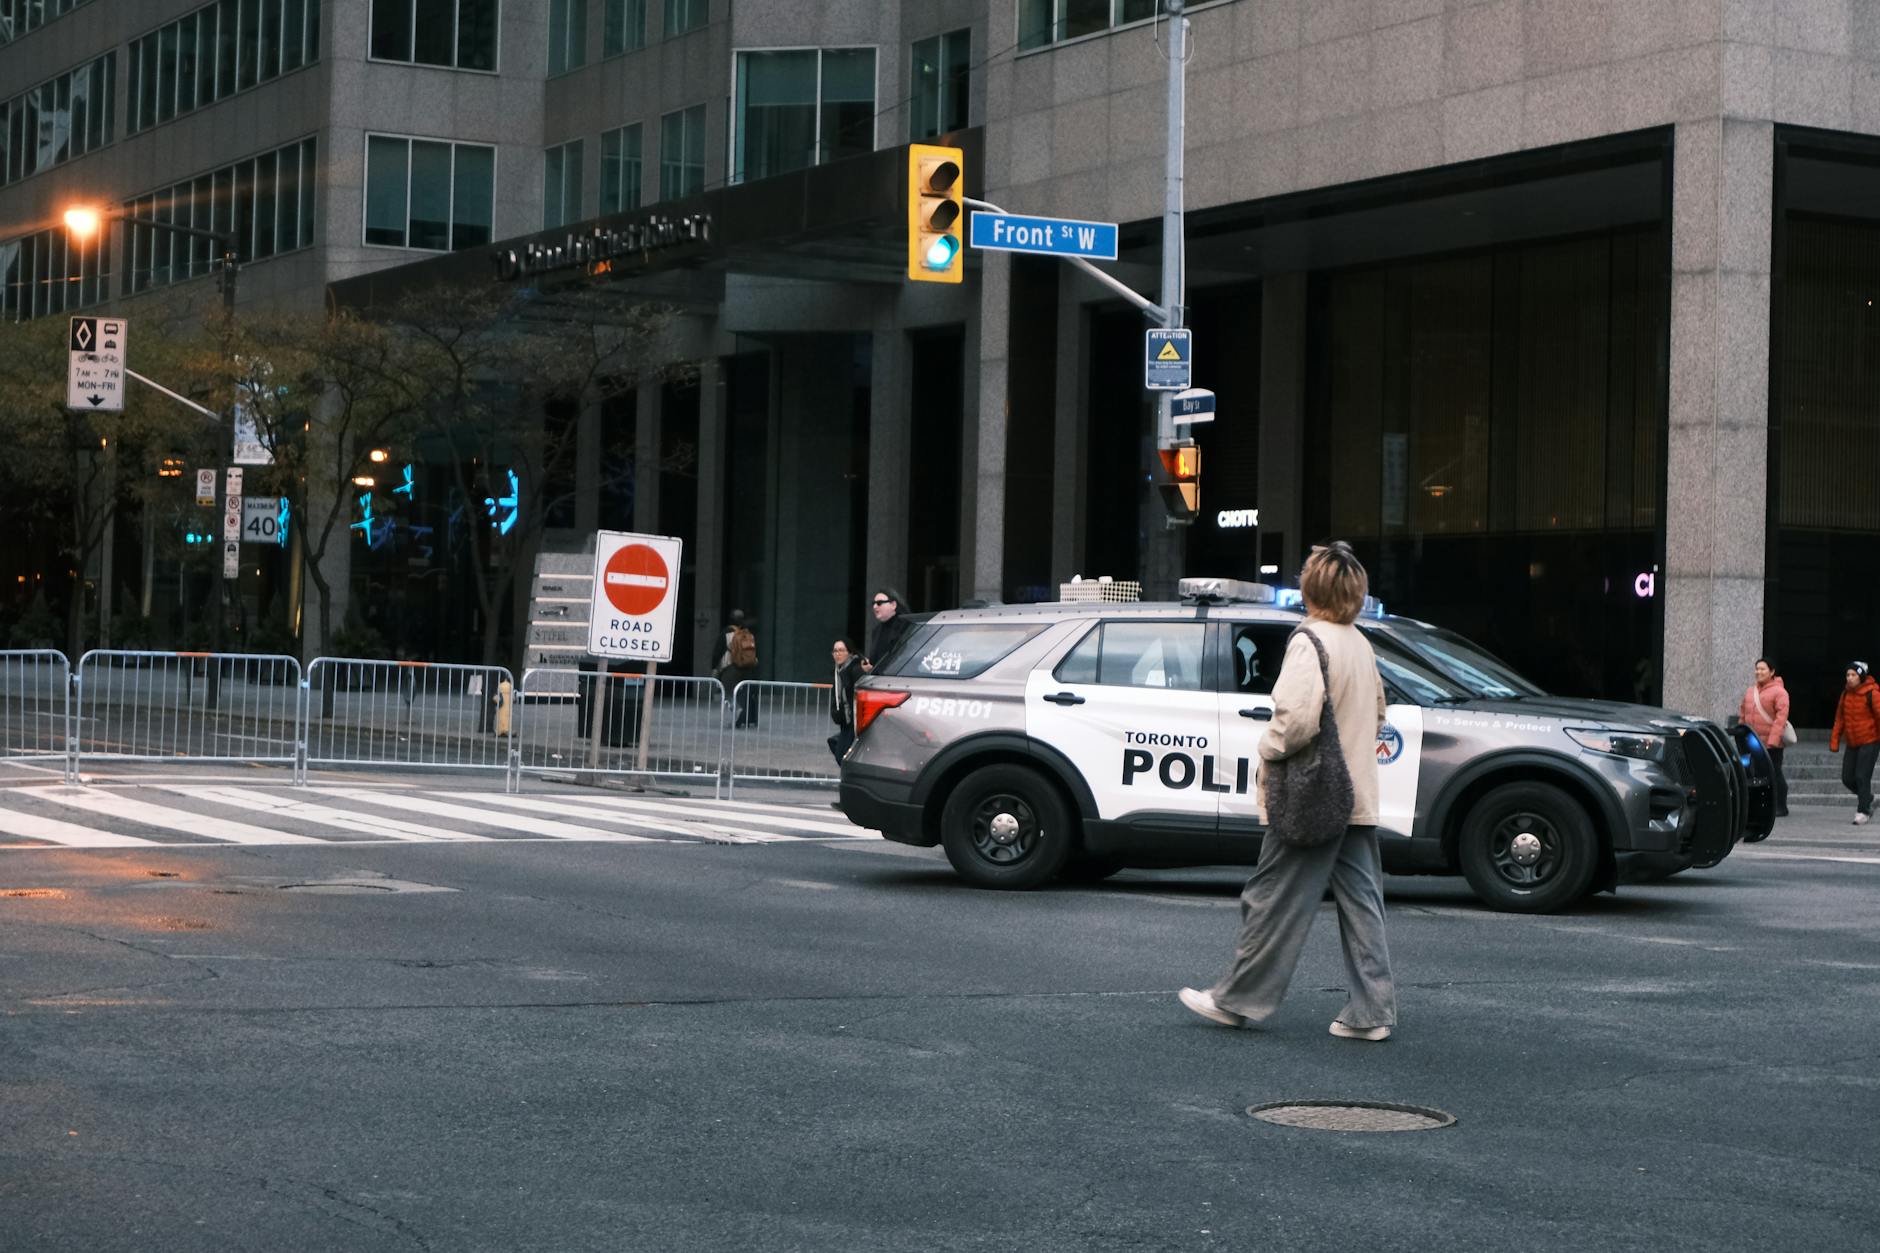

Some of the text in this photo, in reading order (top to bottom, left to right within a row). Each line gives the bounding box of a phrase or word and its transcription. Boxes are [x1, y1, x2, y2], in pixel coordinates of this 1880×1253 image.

[994, 219, 1095, 250] Front St W
[247, 516, 275, 536] 40
[611, 619, 652, 633] ROAD
[600, 636, 660, 651] CLOSED
[915, 697, 993, 719] PSRT01
[1437, 716, 1552, 733] To Serve & Protect
[1125, 731, 1208, 748] TORONTO
[1122, 748, 1258, 794] POLI
